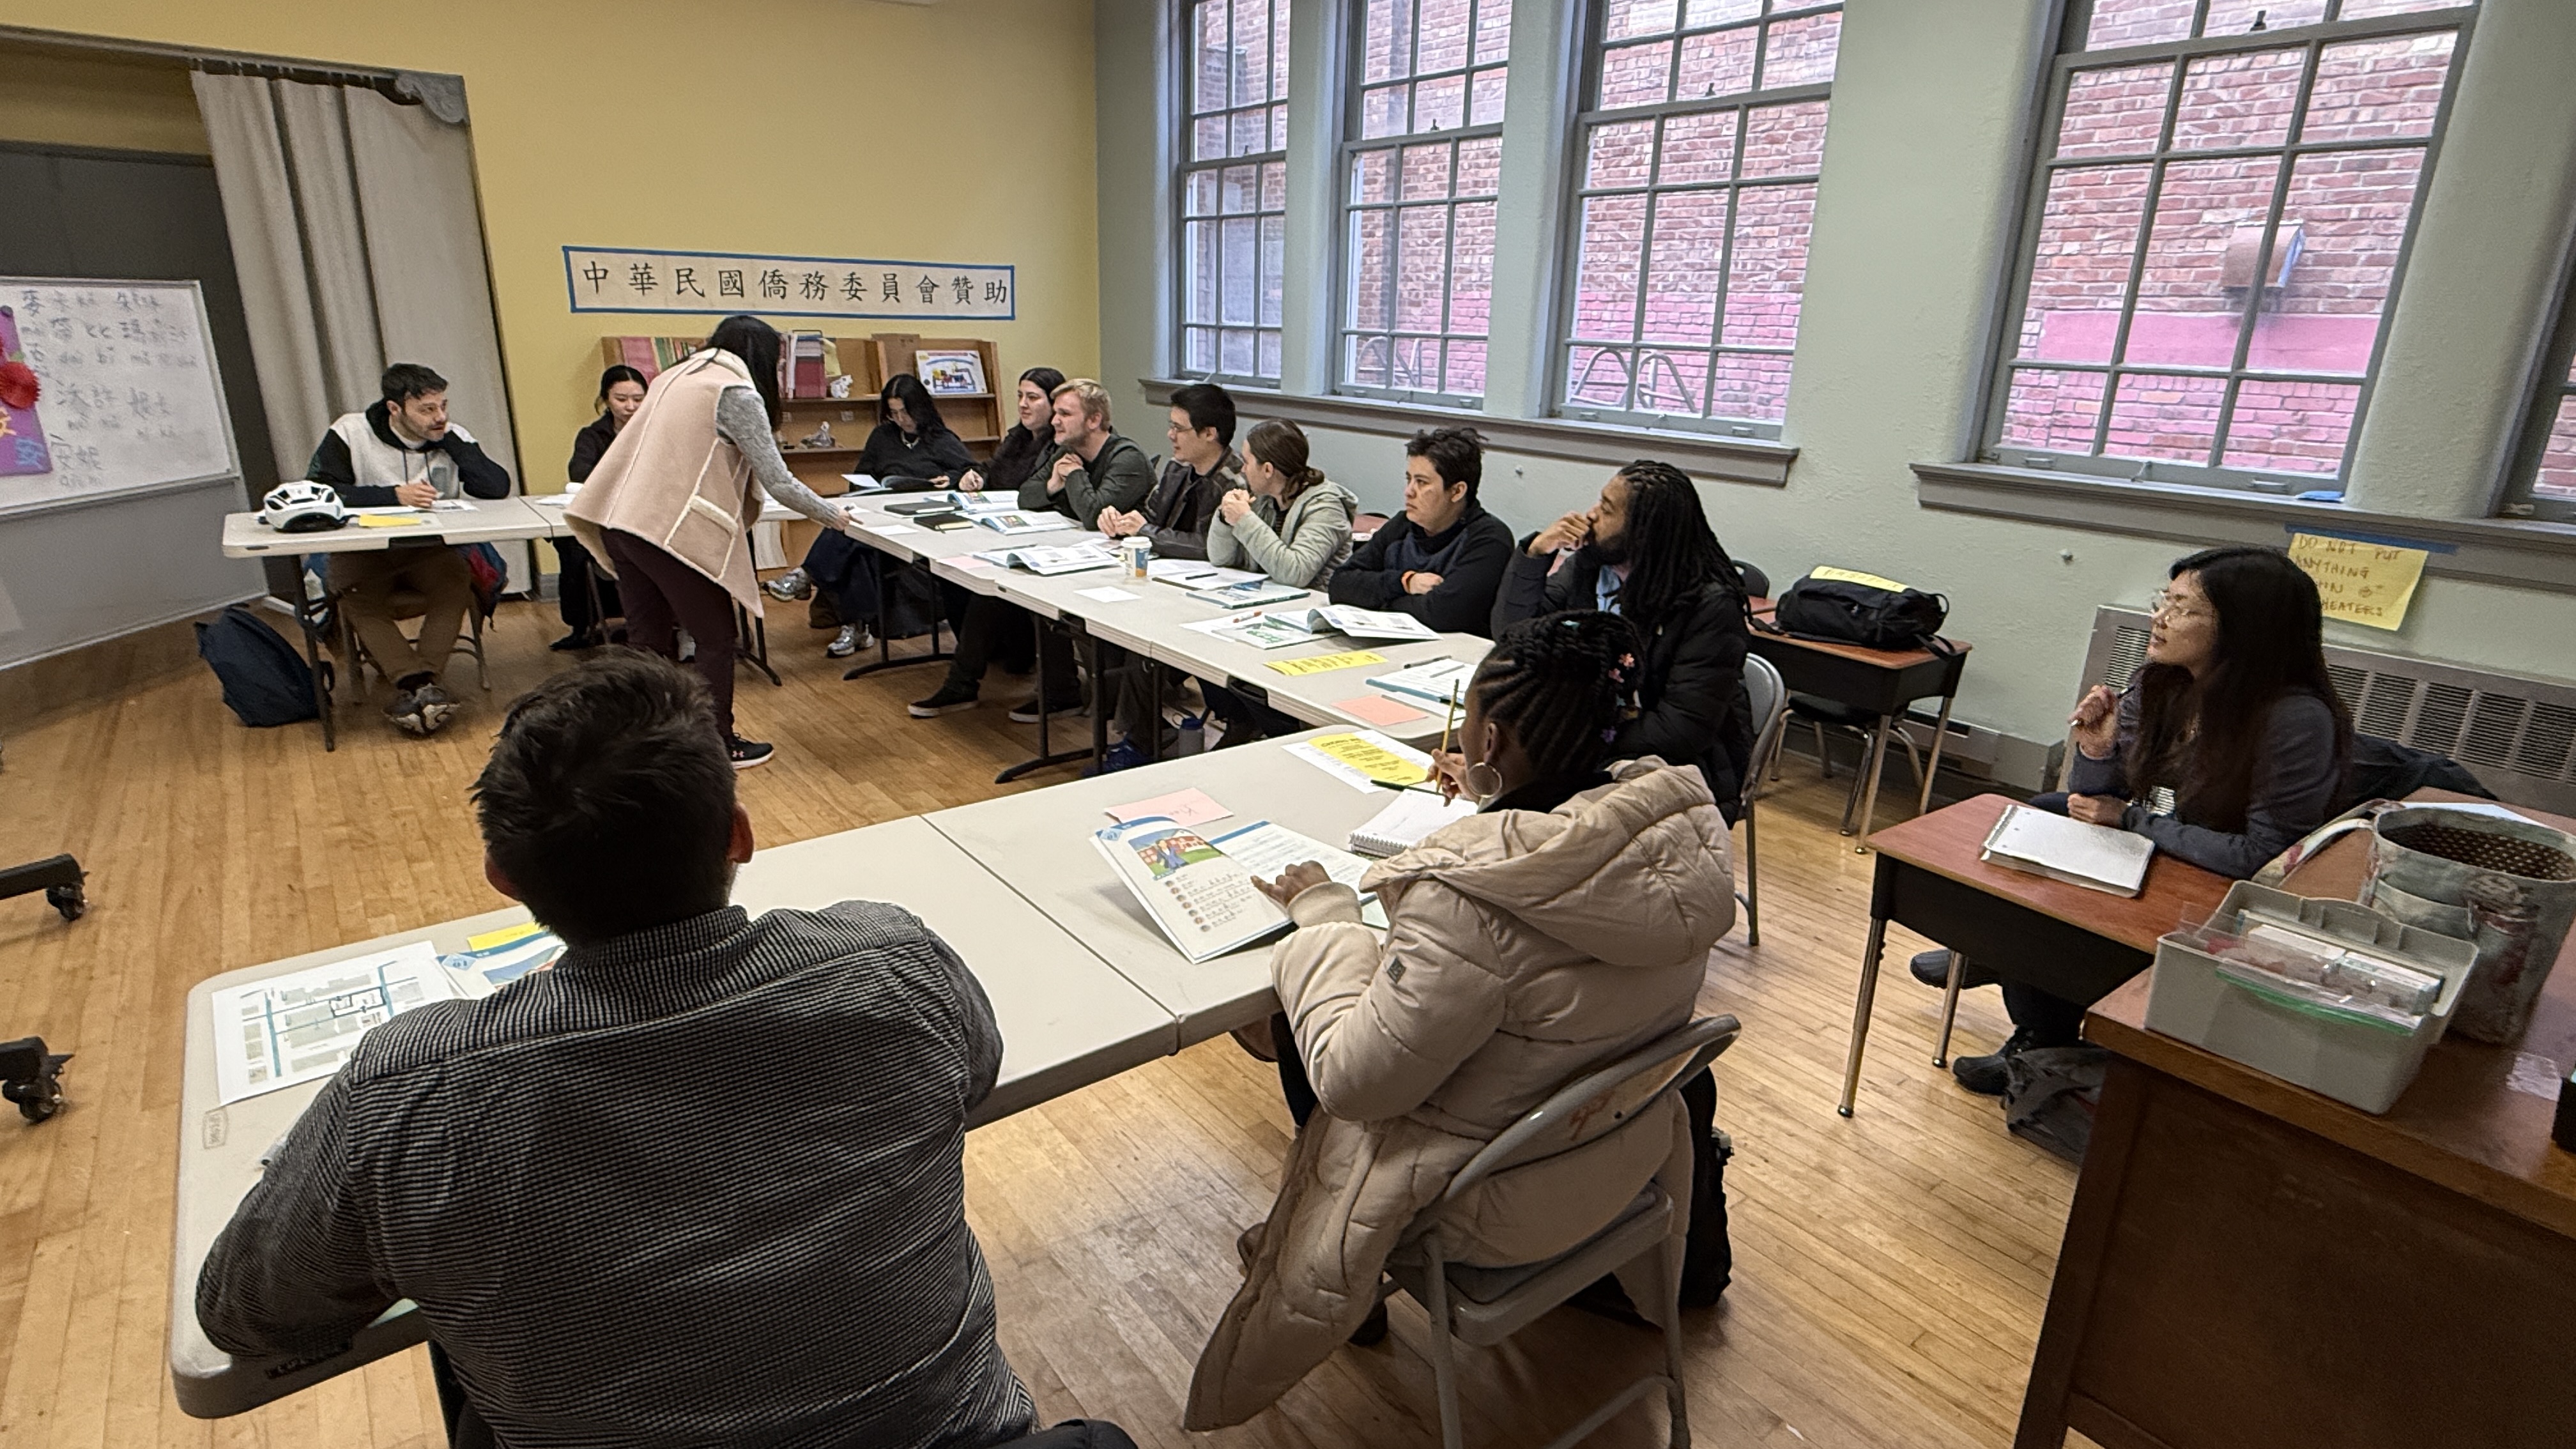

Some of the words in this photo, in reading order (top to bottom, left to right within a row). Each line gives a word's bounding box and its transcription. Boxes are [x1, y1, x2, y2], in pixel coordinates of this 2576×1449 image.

[582, 261, 1008, 305] 中華民國僑務委員會贊助
[2298, 534, 2319, 549] DO
[2326, 540, 2357, 555] NOT
[2374, 548, 2404, 561] PUT
